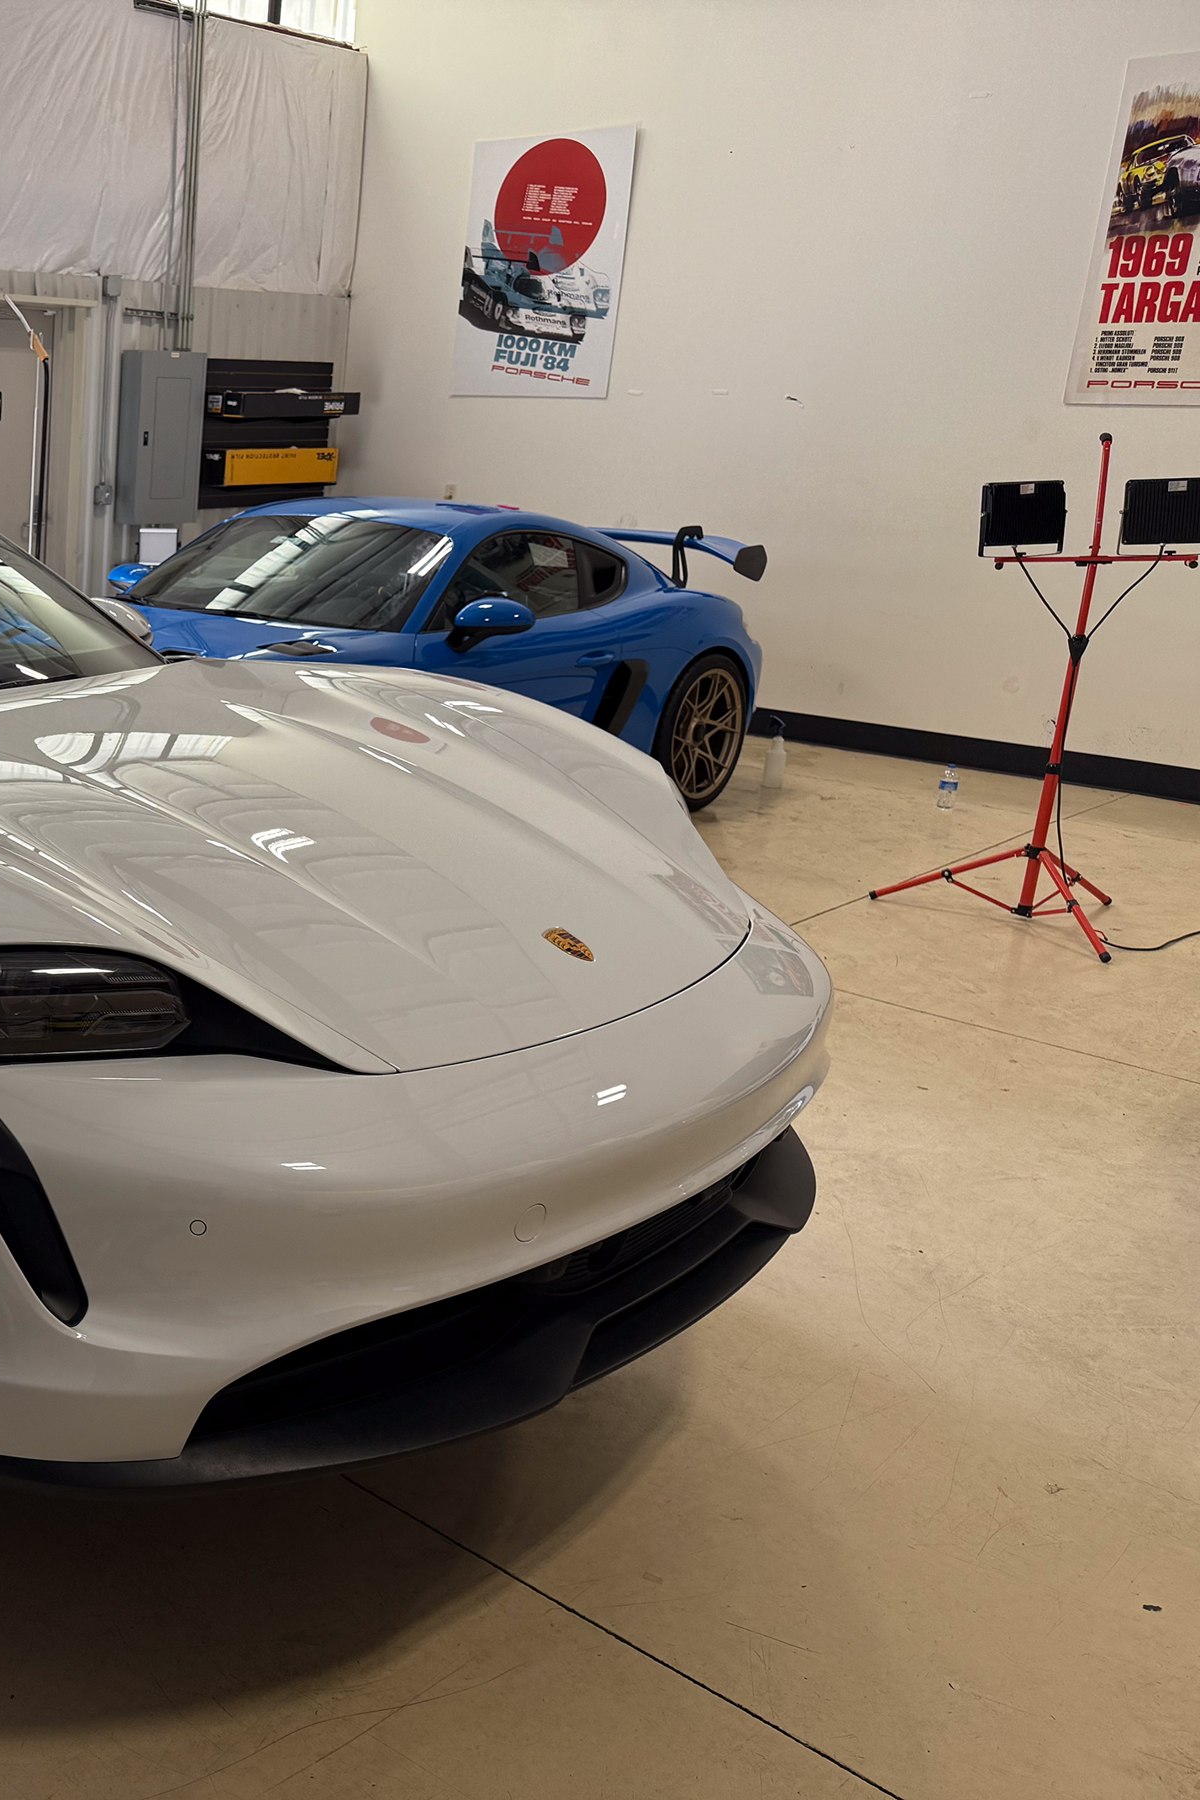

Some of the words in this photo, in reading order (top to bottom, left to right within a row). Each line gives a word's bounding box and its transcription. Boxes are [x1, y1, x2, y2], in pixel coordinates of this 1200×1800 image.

[1107, 233, 1194, 279] 1969
[1098, 281, 1200, 325] TARGA
[525, 314, 567, 327] Rothmans
[496, 334, 542, 353] 1000
[542, 339, 577, 359] KM
[493, 348, 537, 368] FUJI
[538, 356, 570, 372] '84
[490, 364, 591, 387] PORSCHE
[324, 401, 345, 411] PRIME
[316, 452, 336, 462] XPEL
